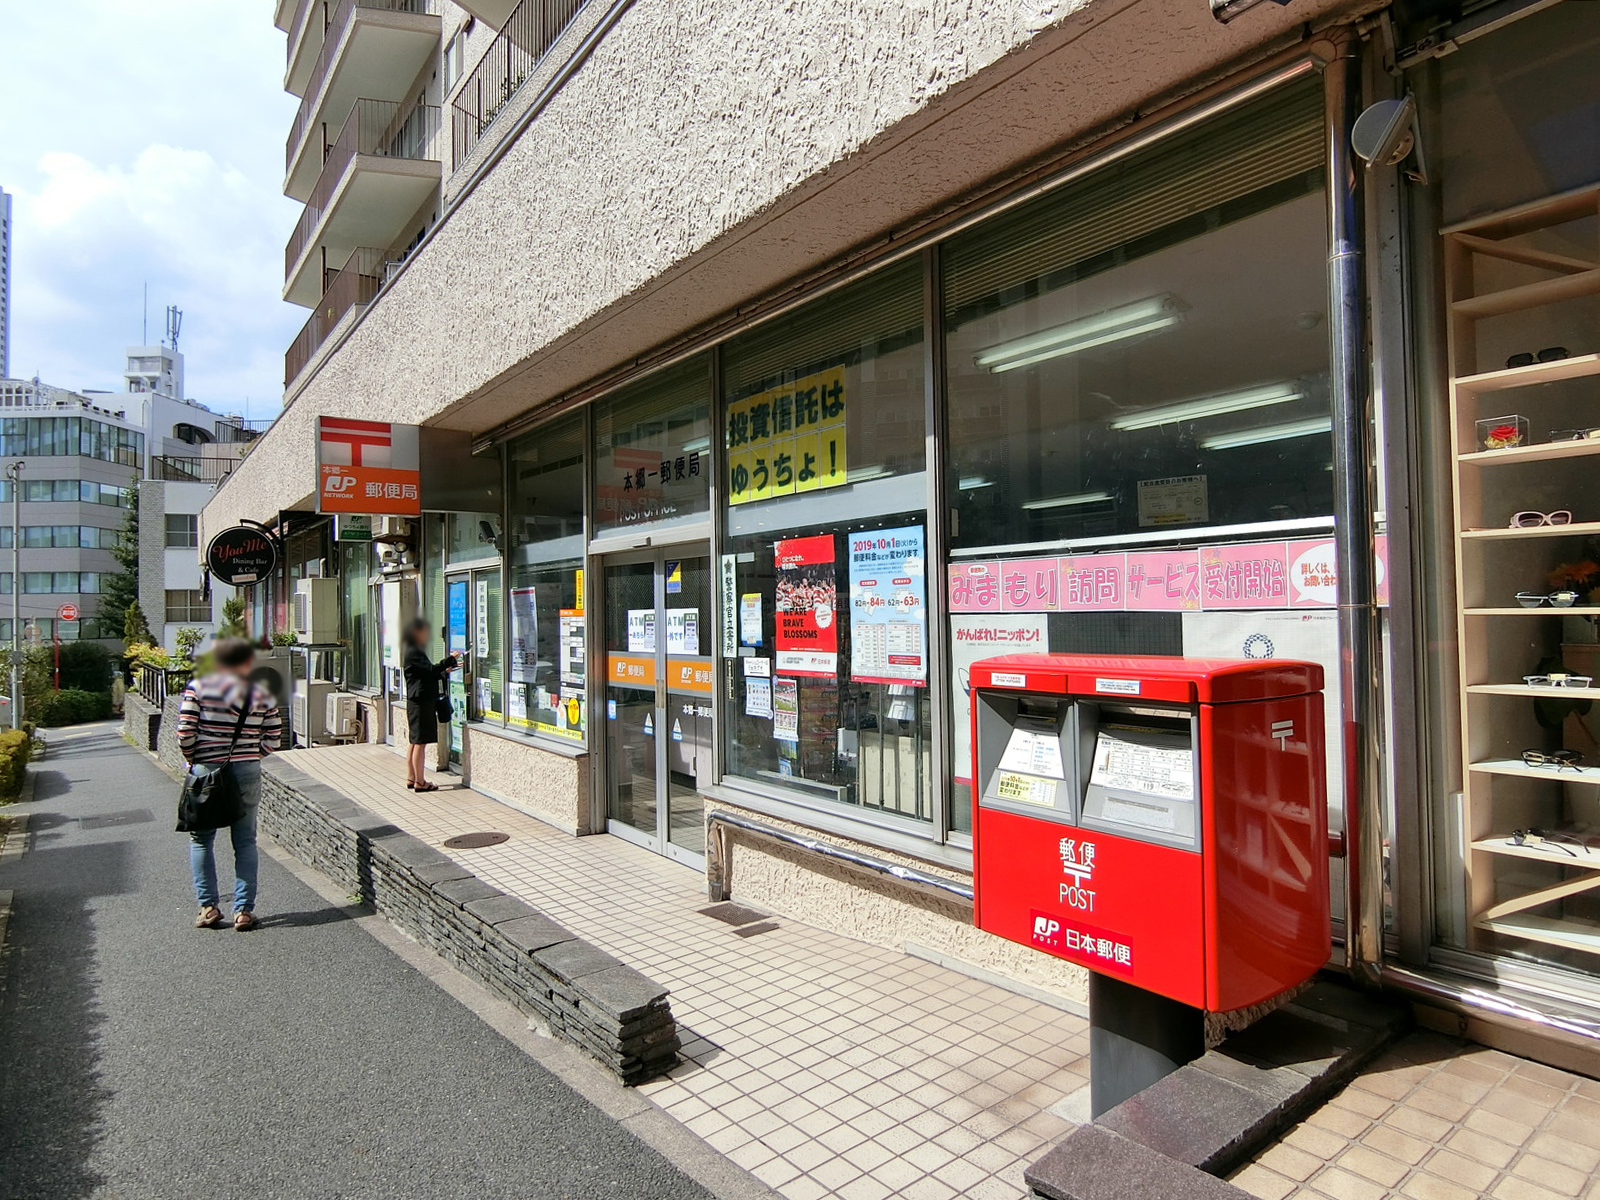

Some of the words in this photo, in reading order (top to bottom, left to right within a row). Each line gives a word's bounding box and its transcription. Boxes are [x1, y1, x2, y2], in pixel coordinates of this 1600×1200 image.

[729, 379, 845, 448] 投資信託は
[322, 466, 349, 475] 本郷一
[623, 452, 700, 493] 本郷一郵便局
[731, 440, 836, 495] ゆうちょ！
[325, 476, 357, 492] JP
[365, 482, 418, 500] 郵便局
[853, 537, 918, 552] 2019年10月1日(火)から
[232, 557, 254, 565] Dining
[870, 597, 885, 607] 84円
[904, 595, 919, 606] 63円
[783, 607, 794, 616] WE
[795, 607, 807, 616] ARE
[630, 617, 644, 626] ATM
[668, 616, 683, 626] ATM
[783, 619, 804, 627] BRAVE
[783, 630, 818, 638] BLOSSOMS
[956, 628, 1040, 642] がんばれ!ニッポン!
[628, 664, 645, 677] 郵便局
[1059, 837, 1096, 868] 郵便
[1059, 883, 1096, 912] POST
[1032, 934, 1058, 946] POST
[1066, 928, 1131, 966] 日本郵便
